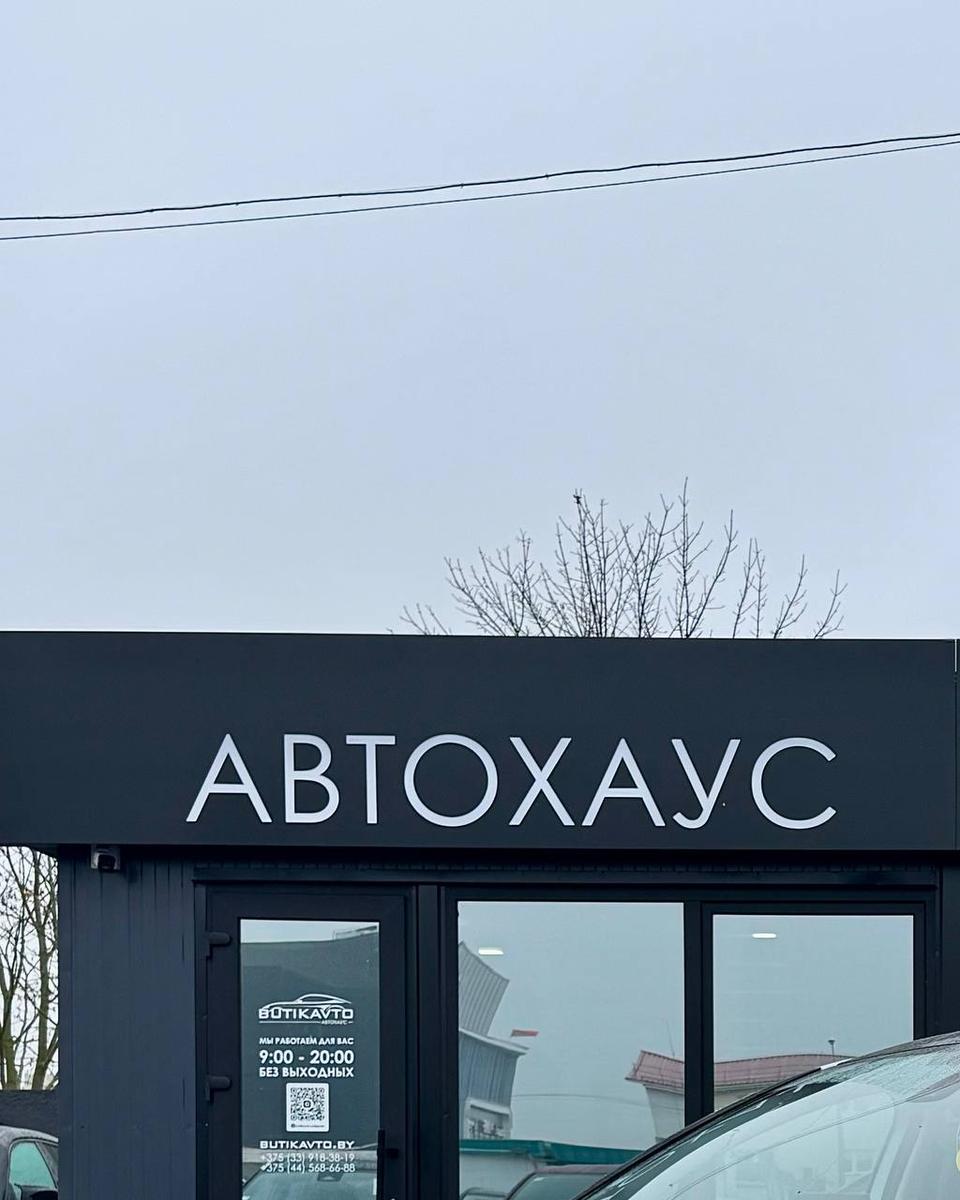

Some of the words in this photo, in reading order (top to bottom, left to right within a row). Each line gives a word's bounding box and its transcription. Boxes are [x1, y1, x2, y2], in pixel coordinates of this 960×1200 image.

[186, 733, 837, 830] АВТОХАУС
[258, 1008, 354, 1020] BUTIKAVTO
[259, 1037, 274, 1045] МЫ
[275, 1037, 317, 1045] РАБОТАЕМ
[318, 1037, 336, 1046] ДЛЯ
[337, 1037, 354, 1045] ВАС
[259, 1049, 294, 1064] 9:00
[309, 1049, 355, 1064] 20:00
[259, 1066, 279, 1078] БЕЗ
[282, 1066, 354, 1079] ВЫХОДНЫХ
[260, 1140, 355, 1149] BUTIKAVTO.BY
[287, 1152, 305, 1163] (33)
[308, 1153, 355, 1163] 918-38-19
[287, 1162, 305, 1174] (44)
[308, 1163, 355, 1173] 568-66-88
